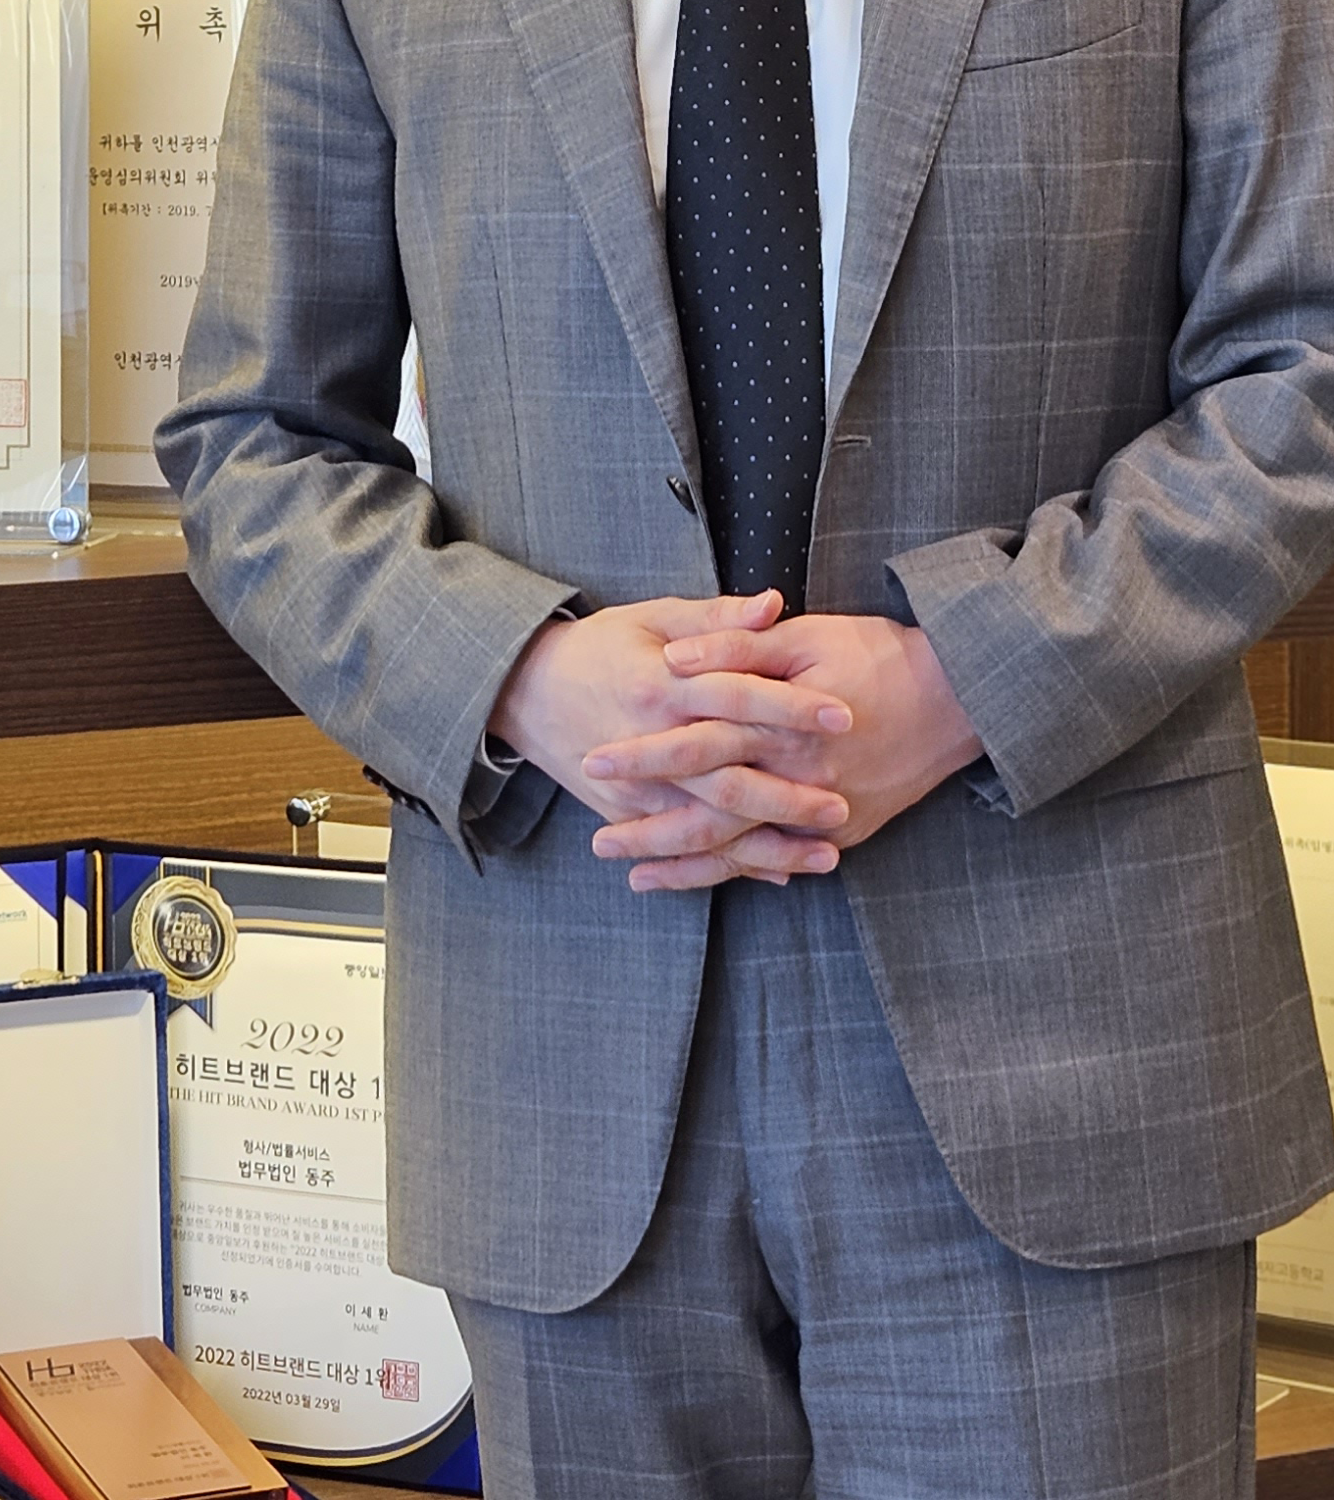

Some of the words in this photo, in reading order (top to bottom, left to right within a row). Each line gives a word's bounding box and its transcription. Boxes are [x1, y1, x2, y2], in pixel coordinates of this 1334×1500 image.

[99, 134, 143, 152] 귀하를
[242, 1018, 344, 1058] 2022
[176, 1054, 295, 1091] 히트브랜드
[310, 1069, 357, 1100] 대상
[169, 1086, 195, 1101] THE
[199, 1088, 223, 1105] HIT
[227, 1090, 278, 1112] BRAND
[282, 1100, 339, 1118] AWARD
[345, 1107, 369, 1122] 1ST
[243, 1139, 330, 1161] 형사/법률서비스
[239, 1160, 296, 1183] 법무법인
[305, 1167, 336, 1188] 동주
[183, 1284, 223, 1301] 법무법인
[230, 1290, 249, 1303] 동주
[195, 1304, 236, 1316] COMPANY
[354, 1323, 379, 1334] NAME
[195, 1345, 235, 1368] 2022
[240, 1350, 322, 1379] 히트브랜드
[327, 1362, 359, 1384] 대상
[365, 1368, 391, 1390] 1위
[242, 1387, 282, 1405] 2022년
[286, 1394, 311, 1410] 03월
[315, 1396, 341, 1412] 29일
